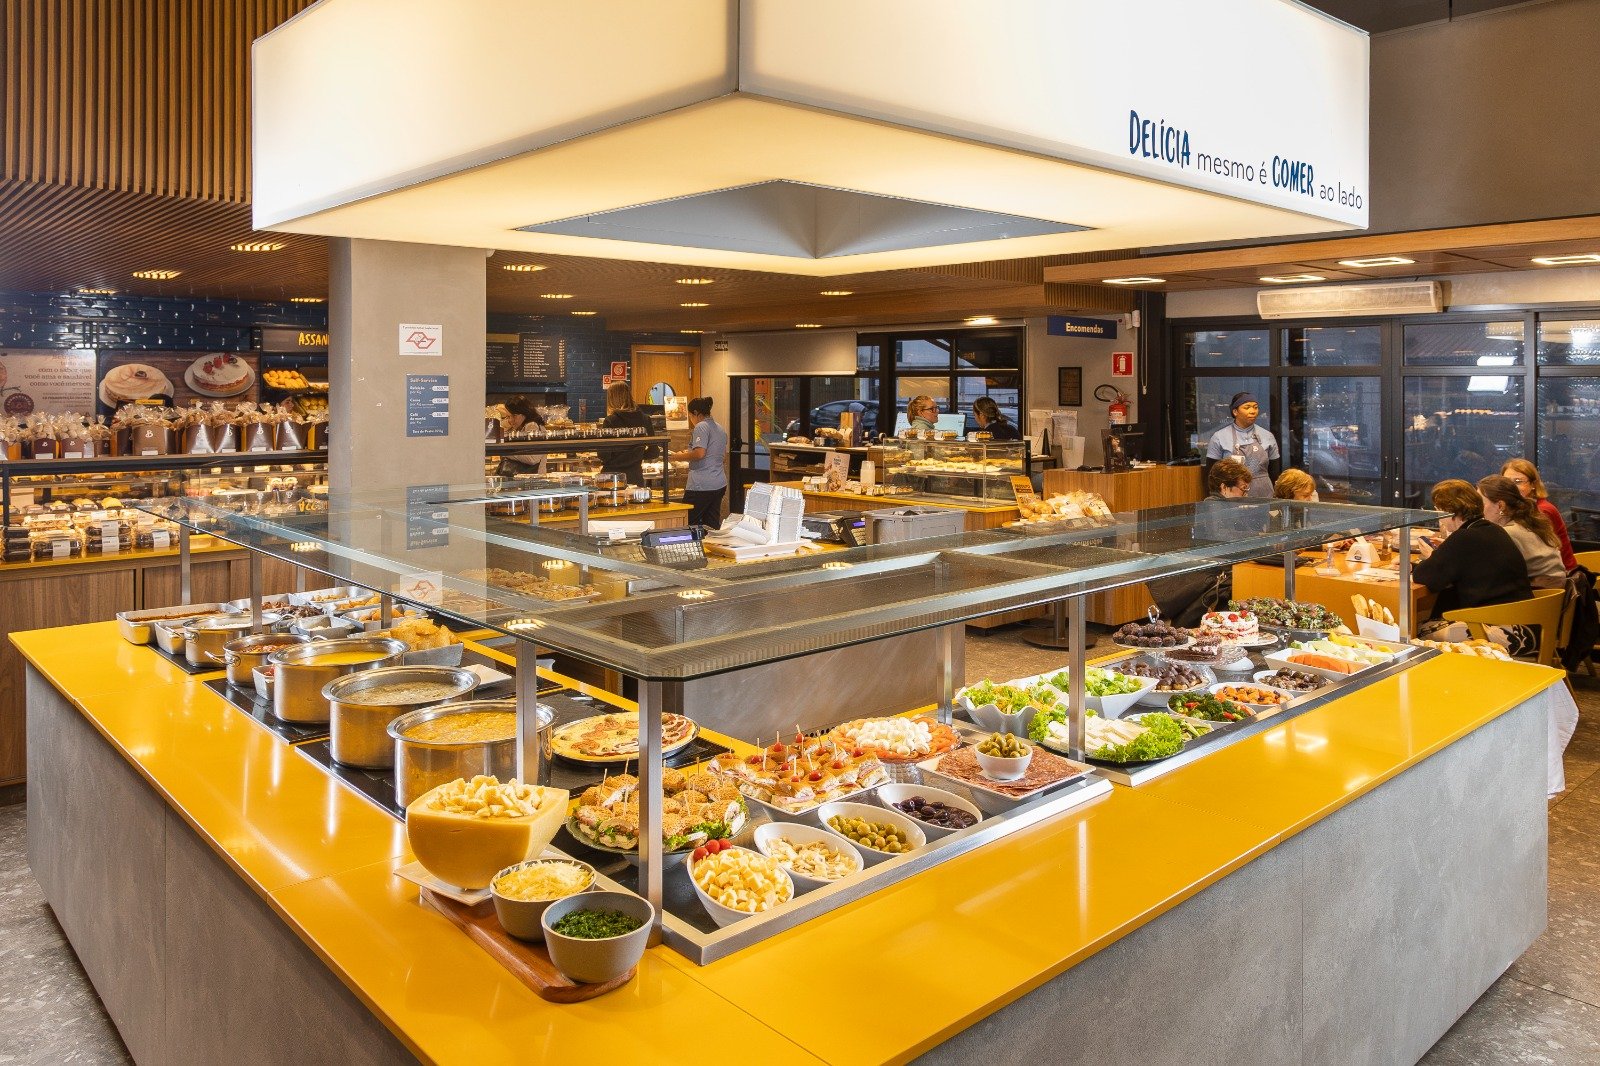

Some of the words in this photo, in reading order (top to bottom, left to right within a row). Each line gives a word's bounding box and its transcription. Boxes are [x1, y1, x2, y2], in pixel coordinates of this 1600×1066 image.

[1130, 110, 1190, 169] DELÍCIA
[1197, 152, 1254, 181] mesmo
[1259, 161, 1267, 185] é
[1272, 155, 1314, 197] COMER
[1320, 184, 1334, 201] ao
[1338, 182, 1362, 209] lado
[1065, 322, 1104, 334] Encomendas
